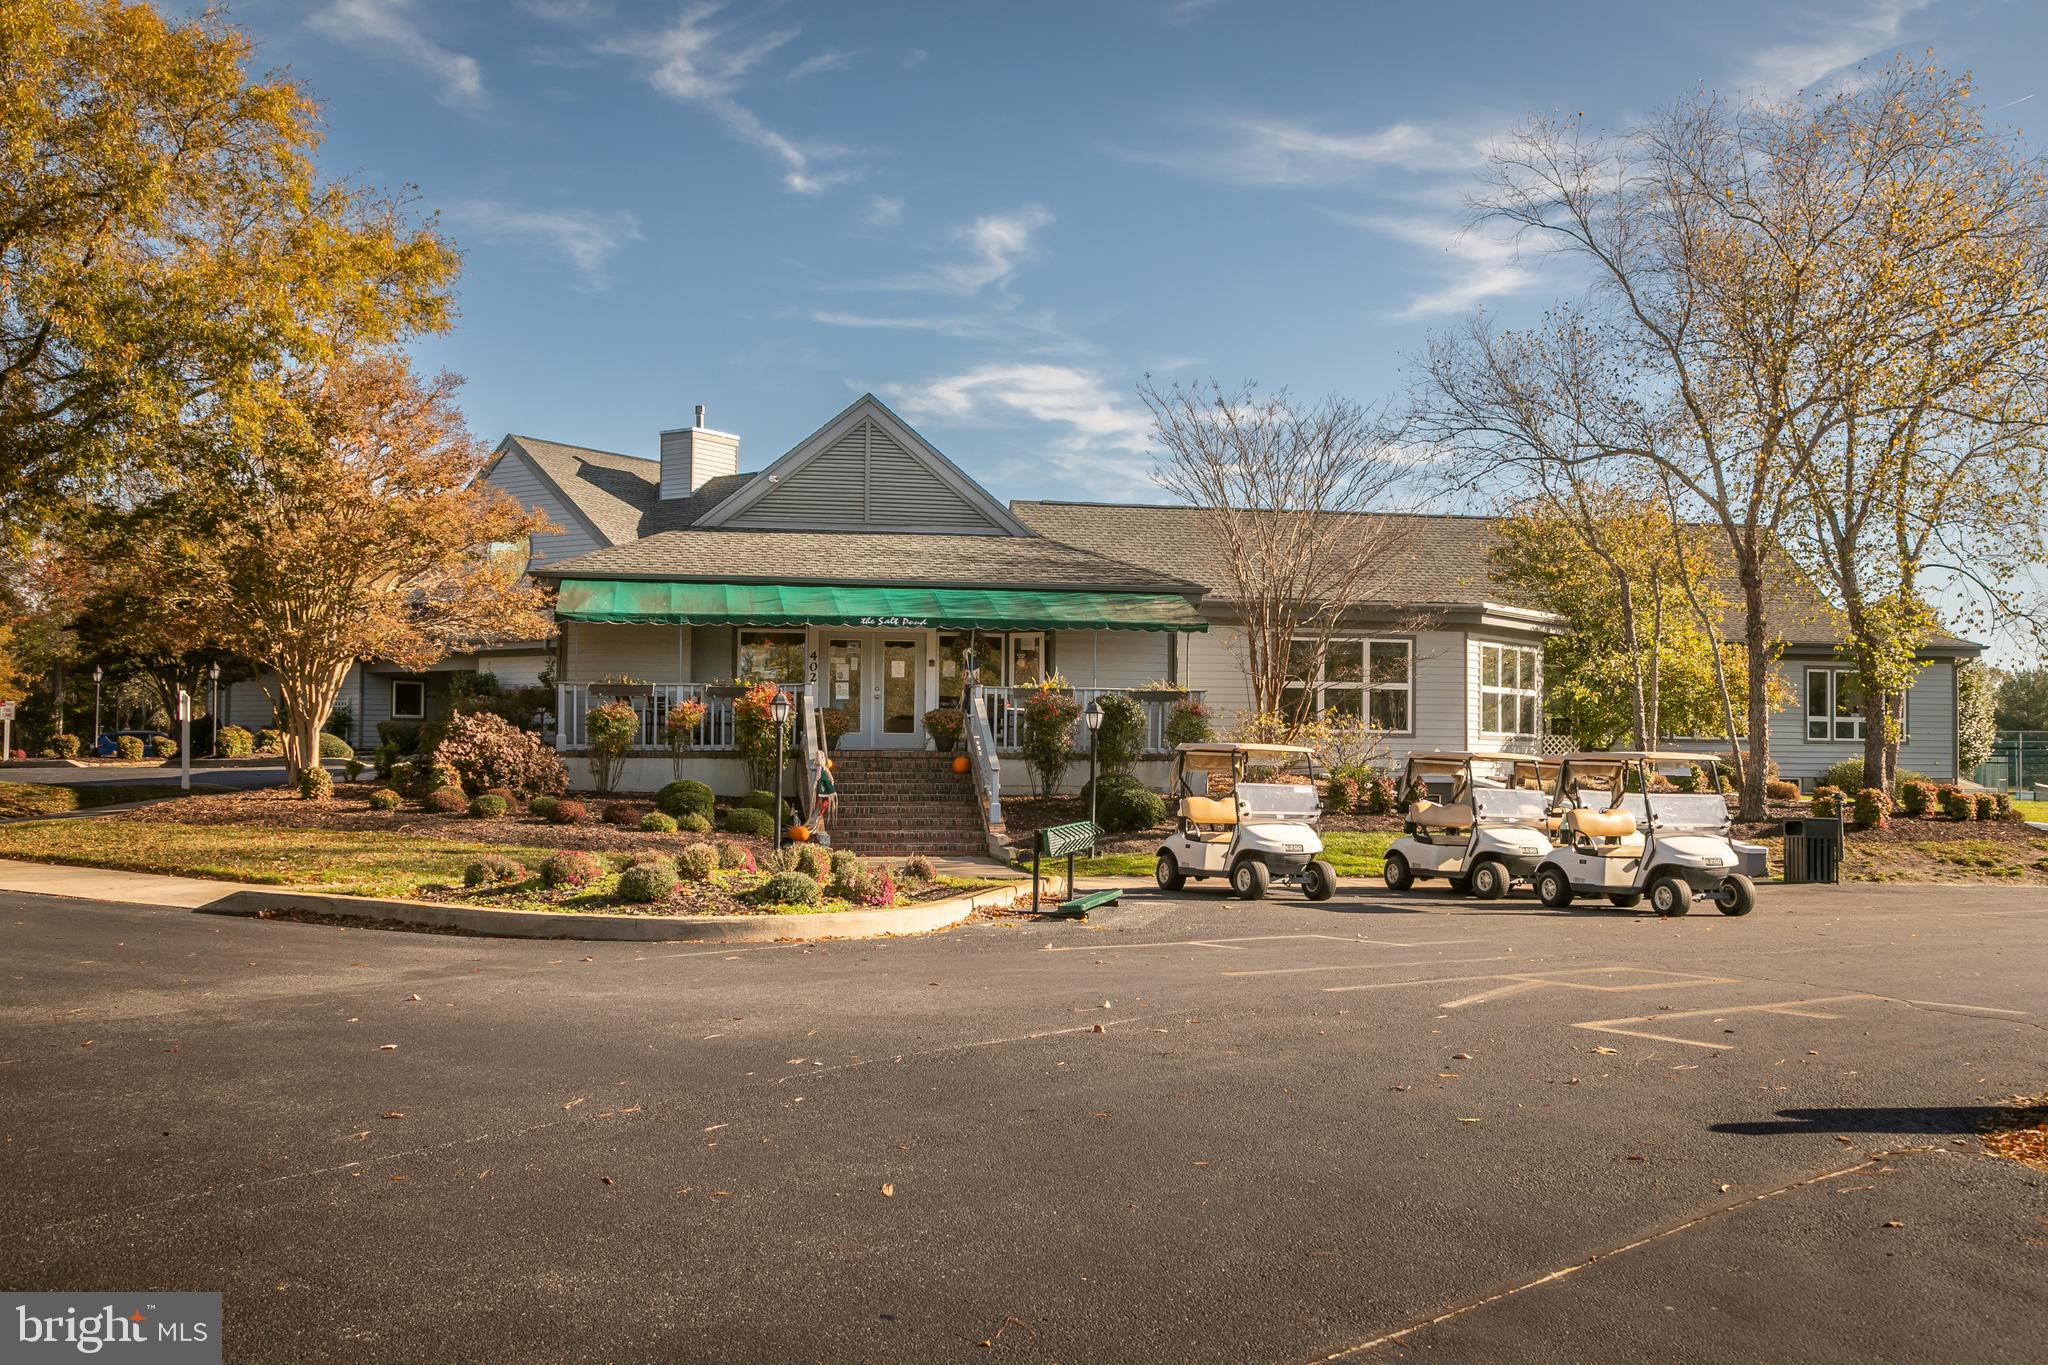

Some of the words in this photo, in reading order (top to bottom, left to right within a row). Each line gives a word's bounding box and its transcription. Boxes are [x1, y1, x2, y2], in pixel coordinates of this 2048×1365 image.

[860, 616, 875, 624] the
[878, 616, 899, 625] Salt
[902, 617, 927, 625] Pond
[810, 651, 818, 682] 402
